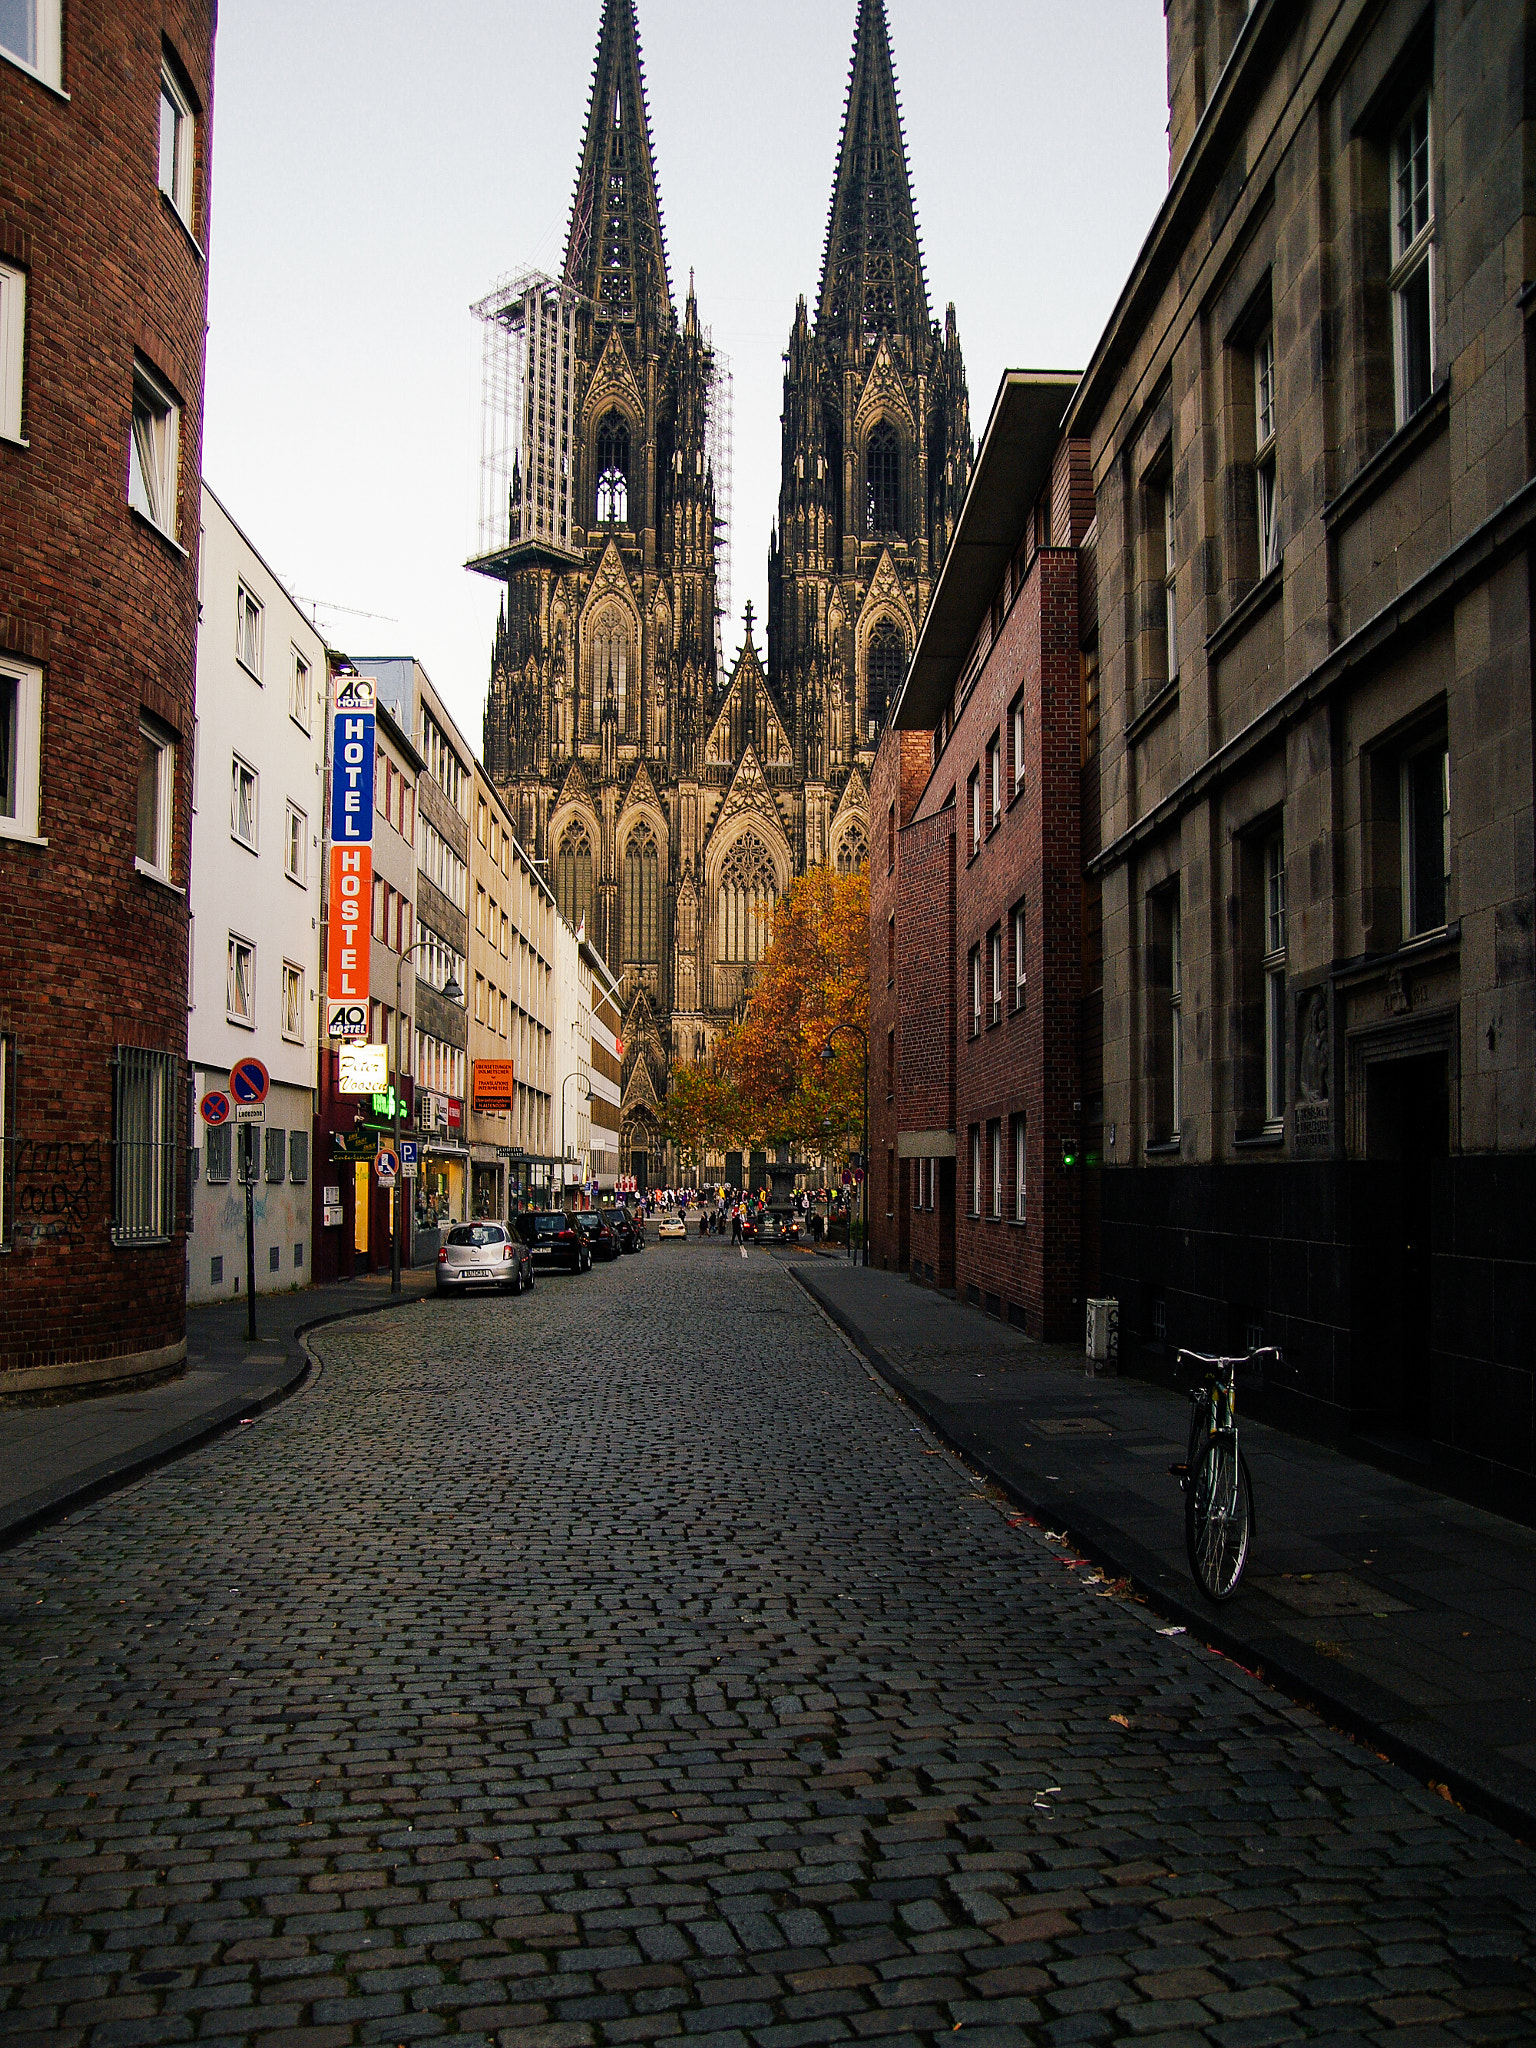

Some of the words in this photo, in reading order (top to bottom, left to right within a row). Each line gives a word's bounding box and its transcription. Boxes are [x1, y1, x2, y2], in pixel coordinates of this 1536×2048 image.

[337, 698, 374, 708] HOTEL
[344, 718, 364, 836] HOTEL
[341, 851, 360, 994] HOSTEL
[330, 1006, 365, 1025] AO
[329, 1024, 366, 1035] HOSTEL
[340, 1055, 379, 1072] Peter
